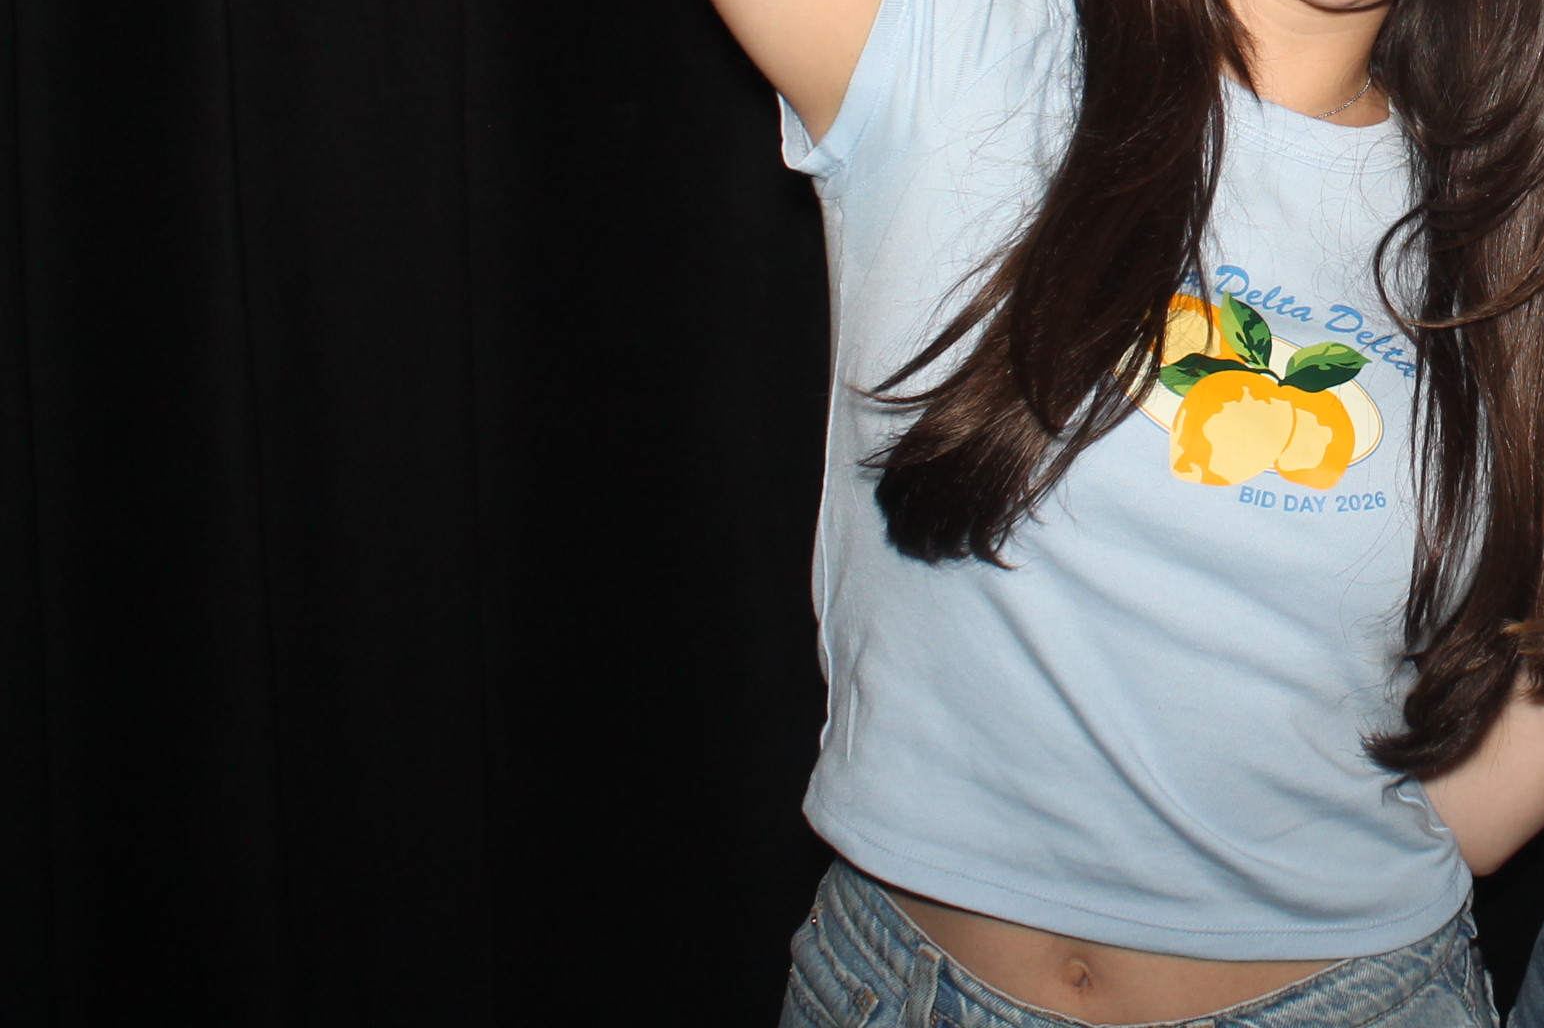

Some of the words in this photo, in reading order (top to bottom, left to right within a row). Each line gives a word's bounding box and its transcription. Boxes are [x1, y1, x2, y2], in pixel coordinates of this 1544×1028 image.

[1215, 264, 1313, 322] Delta
[1325, 304, 1417, 378] Delta
[1238, 485, 1277, 509] BID
[1283, 494, 1327, 513] DAY
[1335, 490, 1387, 513] 2026
